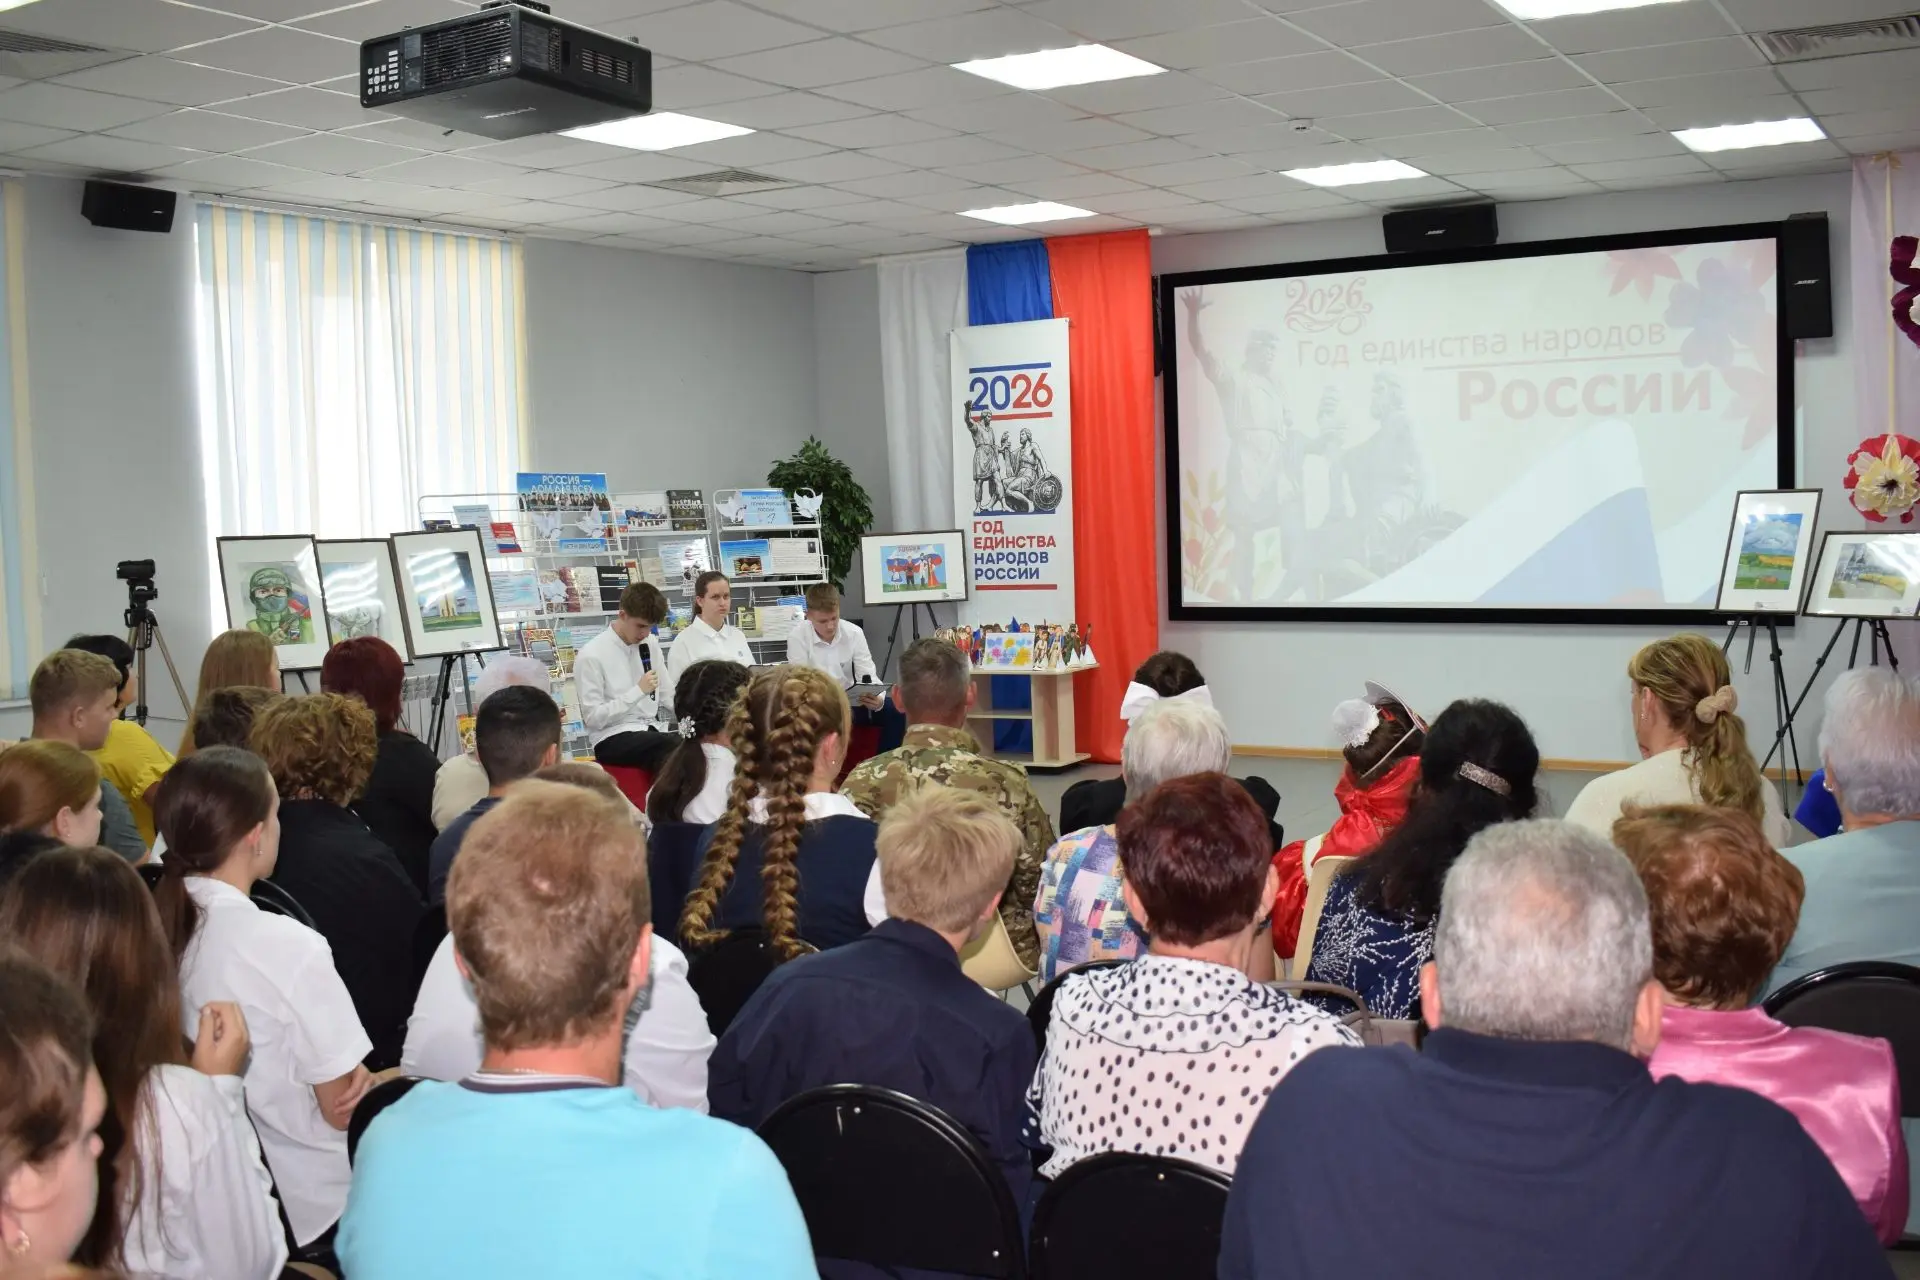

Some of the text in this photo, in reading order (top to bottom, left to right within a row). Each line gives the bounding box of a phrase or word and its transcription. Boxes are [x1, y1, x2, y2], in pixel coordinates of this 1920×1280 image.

[1286, 277, 1372, 319] 2026
[1297, 322, 1666, 367] Год единства народов
[969, 373, 1053, 411] 2026
[1457, 368, 1712, 421] России
[542, 475, 580, 485] РОССИЯ
[531, 484, 552, 493] ДОМ
[973, 520, 1004, 534] ГОД
[973, 535, 1056, 550] ЕДИНСТВА
[974, 551, 1049, 566] НАРОДОВ
[975, 567, 1039, 580] РОССИИ
